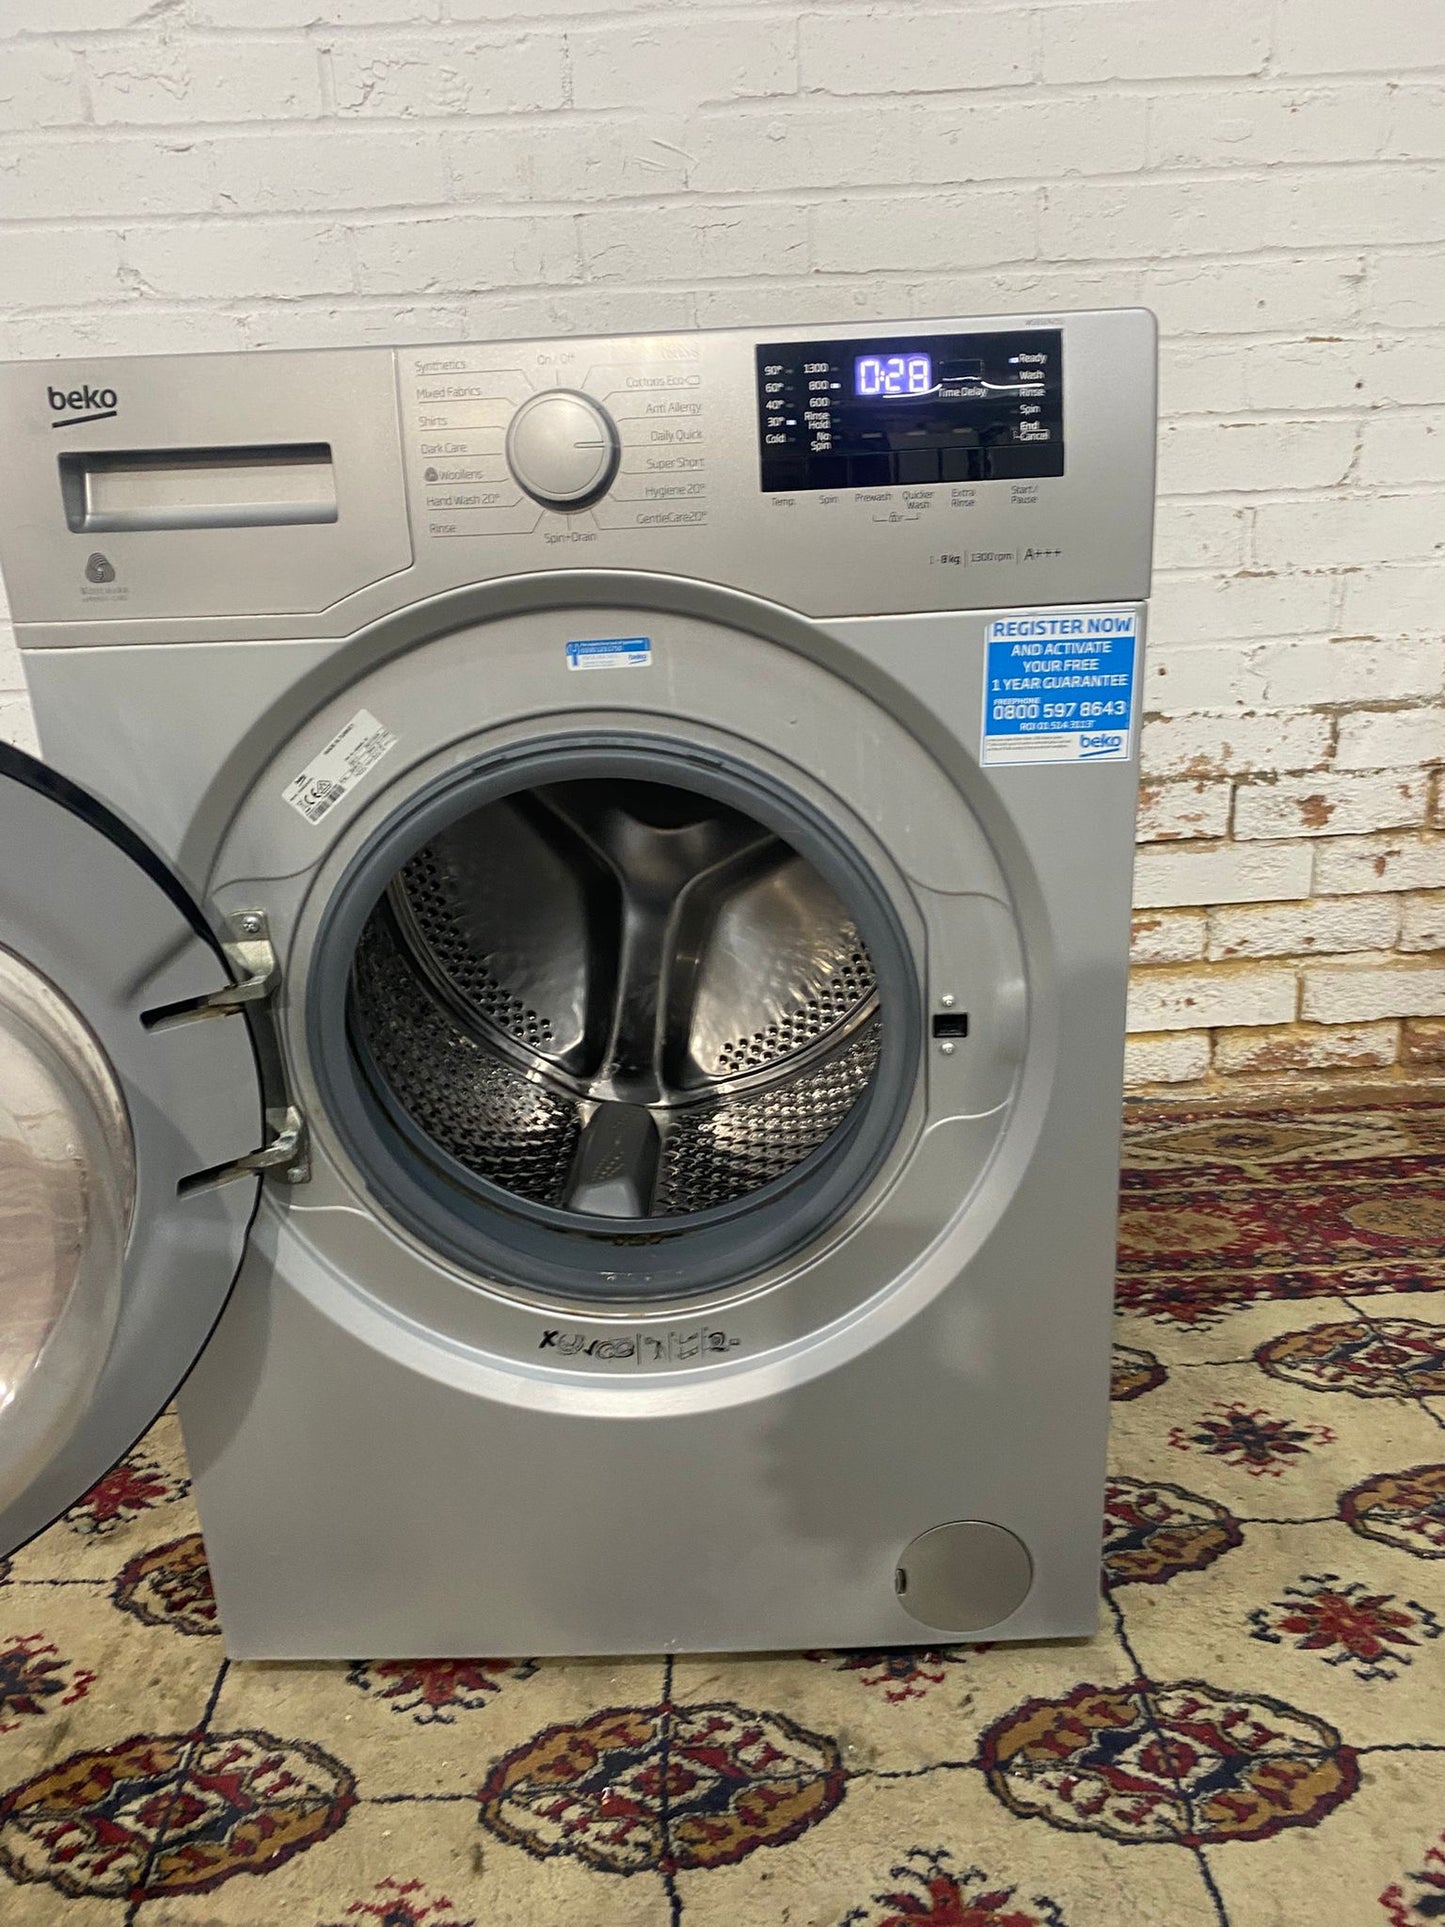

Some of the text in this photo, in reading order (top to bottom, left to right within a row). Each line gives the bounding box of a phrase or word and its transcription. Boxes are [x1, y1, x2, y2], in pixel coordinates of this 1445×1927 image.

[1019, 353, 1048, 365] Ready
[414, 360, 466, 374] Synthetics
[804, 363, 830, 374] 1300
[666, 374, 685, 386] Eco
[859, 358, 931, 394] 0:28
[1019, 370, 1046, 380] Wash
[808, 380, 830, 391] 800
[47, 384, 118, 411] beko
[416, 386, 481, 399] Mixed Fabrics
[938, 386, 988, 399] Time Delay
[1019, 388, 1046, 397] Rinse
[645, 402, 702, 415] Anti Allergy
[809, 397, 831, 408] 600
[804, 411, 831, 421] Rinse
[1019, 404, 1042, 416] Spin
[418, 415, 448, 427] Shirts
[808, 420, 832, 430] Hold
[1019, 421, 1040, 431] End
[650, 429, 703, 443] Daily Quick
[765, 434, 787, 444] Cold
[816, 431, 832, 441] No
[1019, 431, 1049, 441] Cancel
[420, 442, 468, 455] Dark Care
[810, 440, 833, 452] Spin
[646, 456, 704, 470] Super Short
[439, 468, 484, 481] Woollens
[644, 485, 687, 498] Hygiene
[854, 492, 893, 503] Prewash
[901, 489, 934, 502] Quicker
[950, 488, 977, 498] Extra
[426, 496, 453, 507] Hand
[453, 494, 481, 505] Wash
[818, 495, 839, 506] Spin
[906, 501, 931, 511] Wash
[950, 499, 976, 508] Rinse
[1010, 495, 1038, 505] Pause
[428, 523, 457, 534] Rinse
[1023, 548, 1063, 561] A+++
[993, 617, 1133, 637] REGISTER NOW
[1011, 641, 1113, 657] AND ACTIVATE
[1022, 658, 1100, 674] YOUR FREE
[991, 674, 1129, 691] 1 YEAR GUARANTEE
[992, 700, 1127, 720] 0800 597 8643
[1079, 733, 1124, 750] beko
